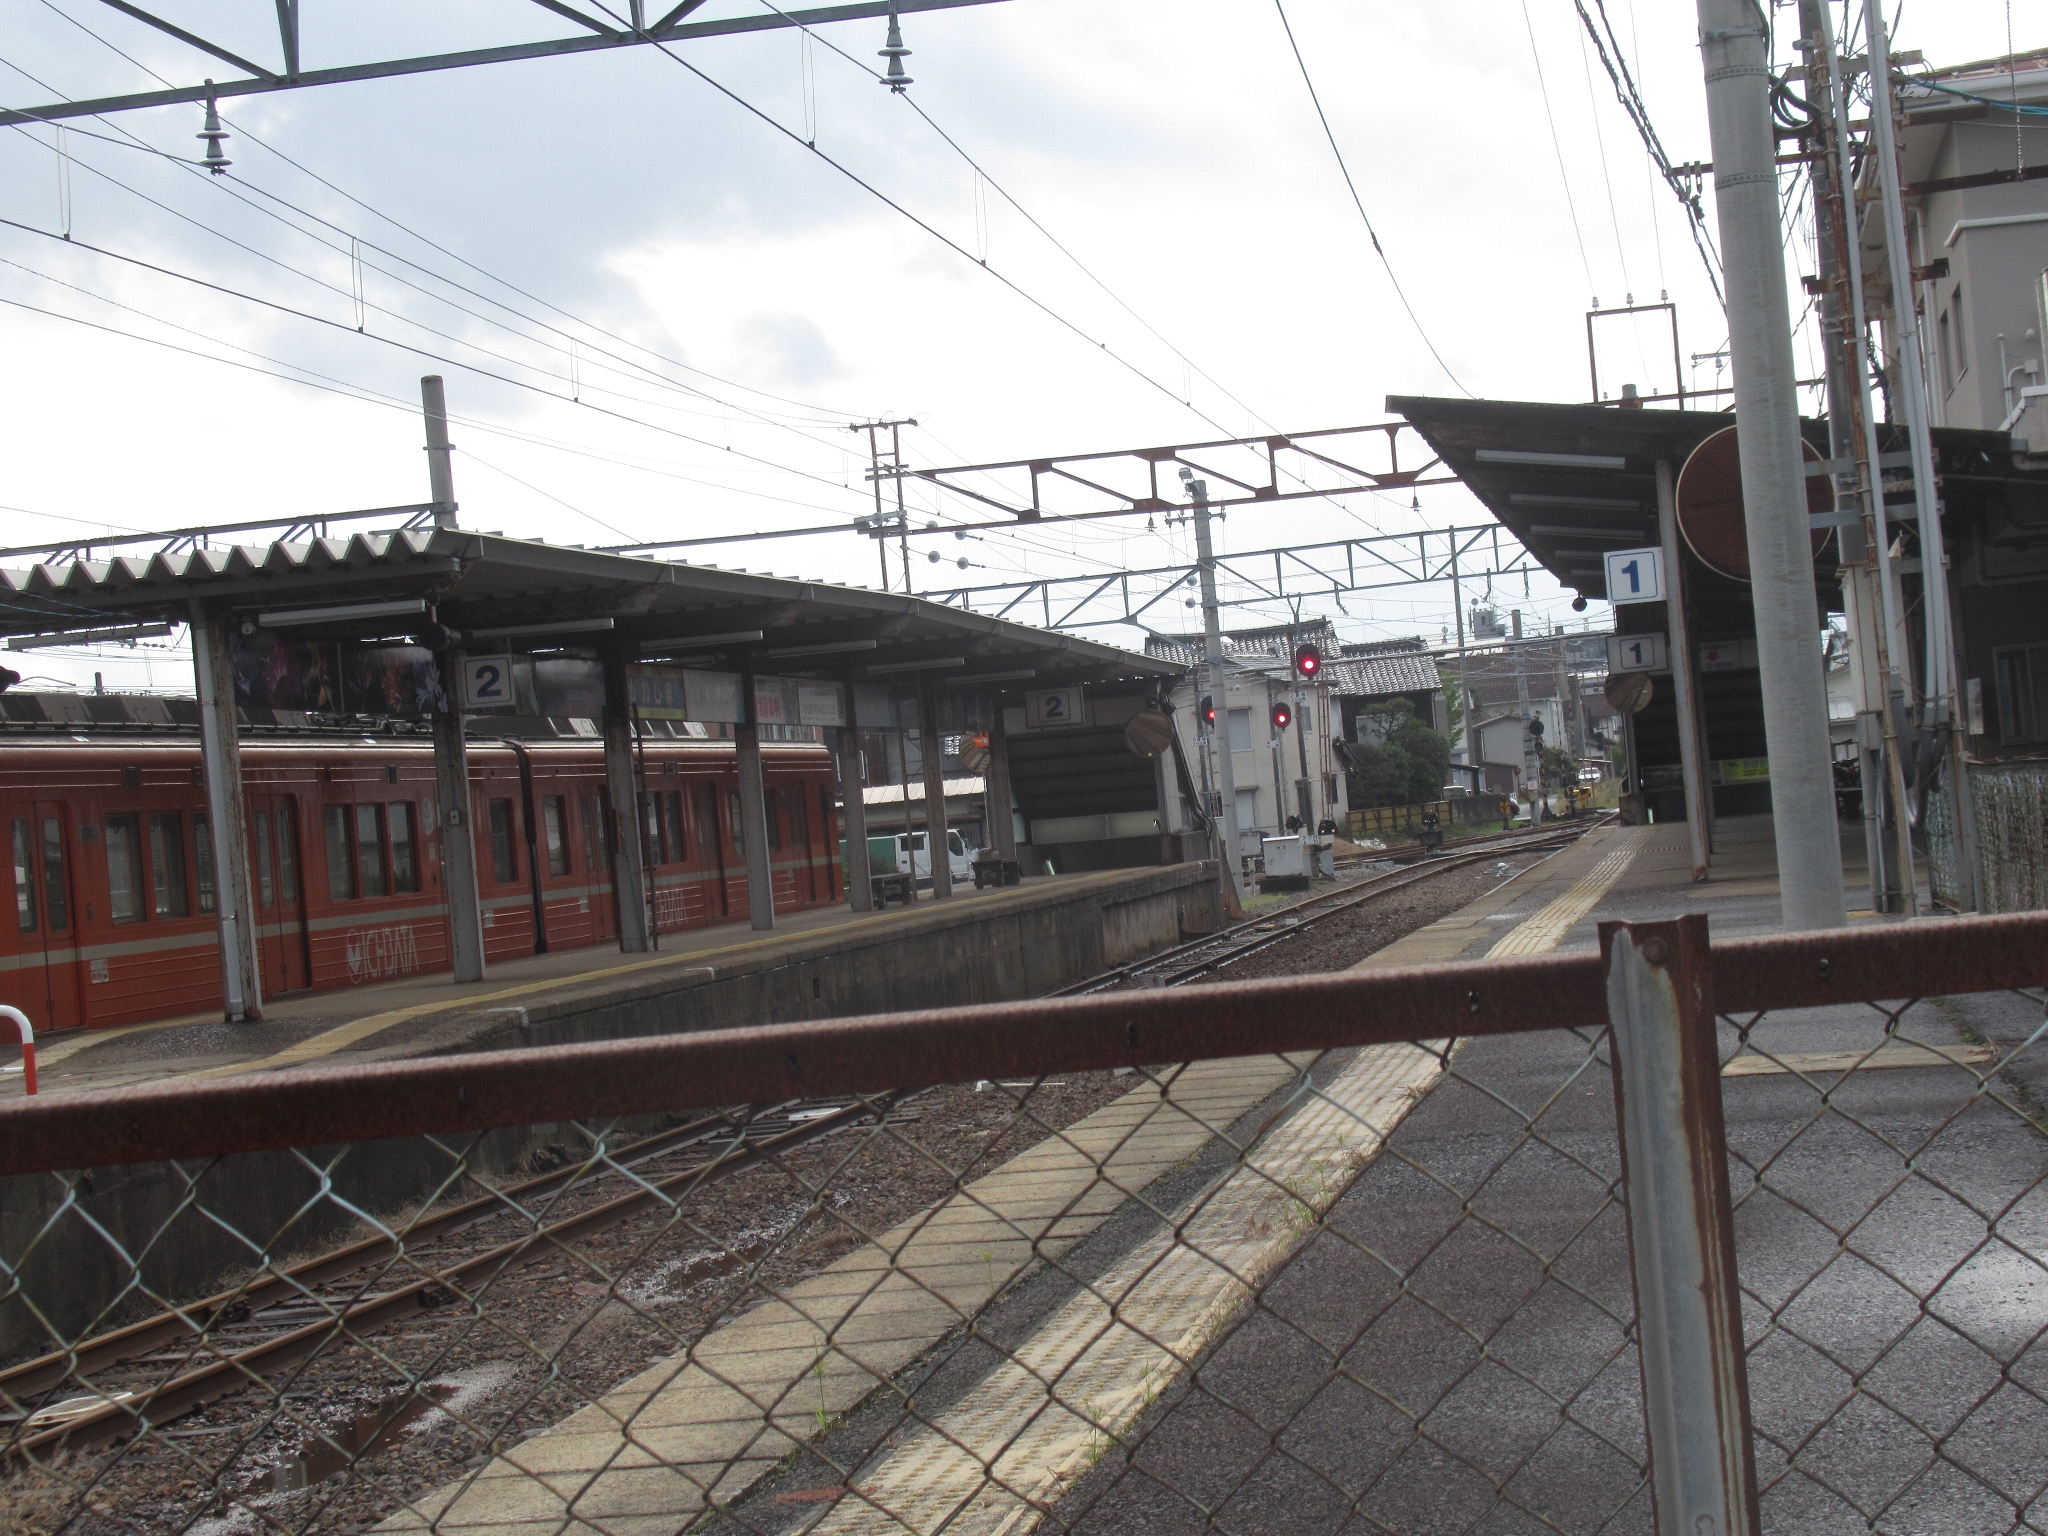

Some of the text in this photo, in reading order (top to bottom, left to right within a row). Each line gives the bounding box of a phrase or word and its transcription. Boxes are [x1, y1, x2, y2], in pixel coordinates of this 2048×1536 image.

[1621, 559, 1640, 593] 1
[1629, 642, 1642, 664] 1
[476, 665, 502, 698] 2
[1045, 695, 1063, 718] 2
